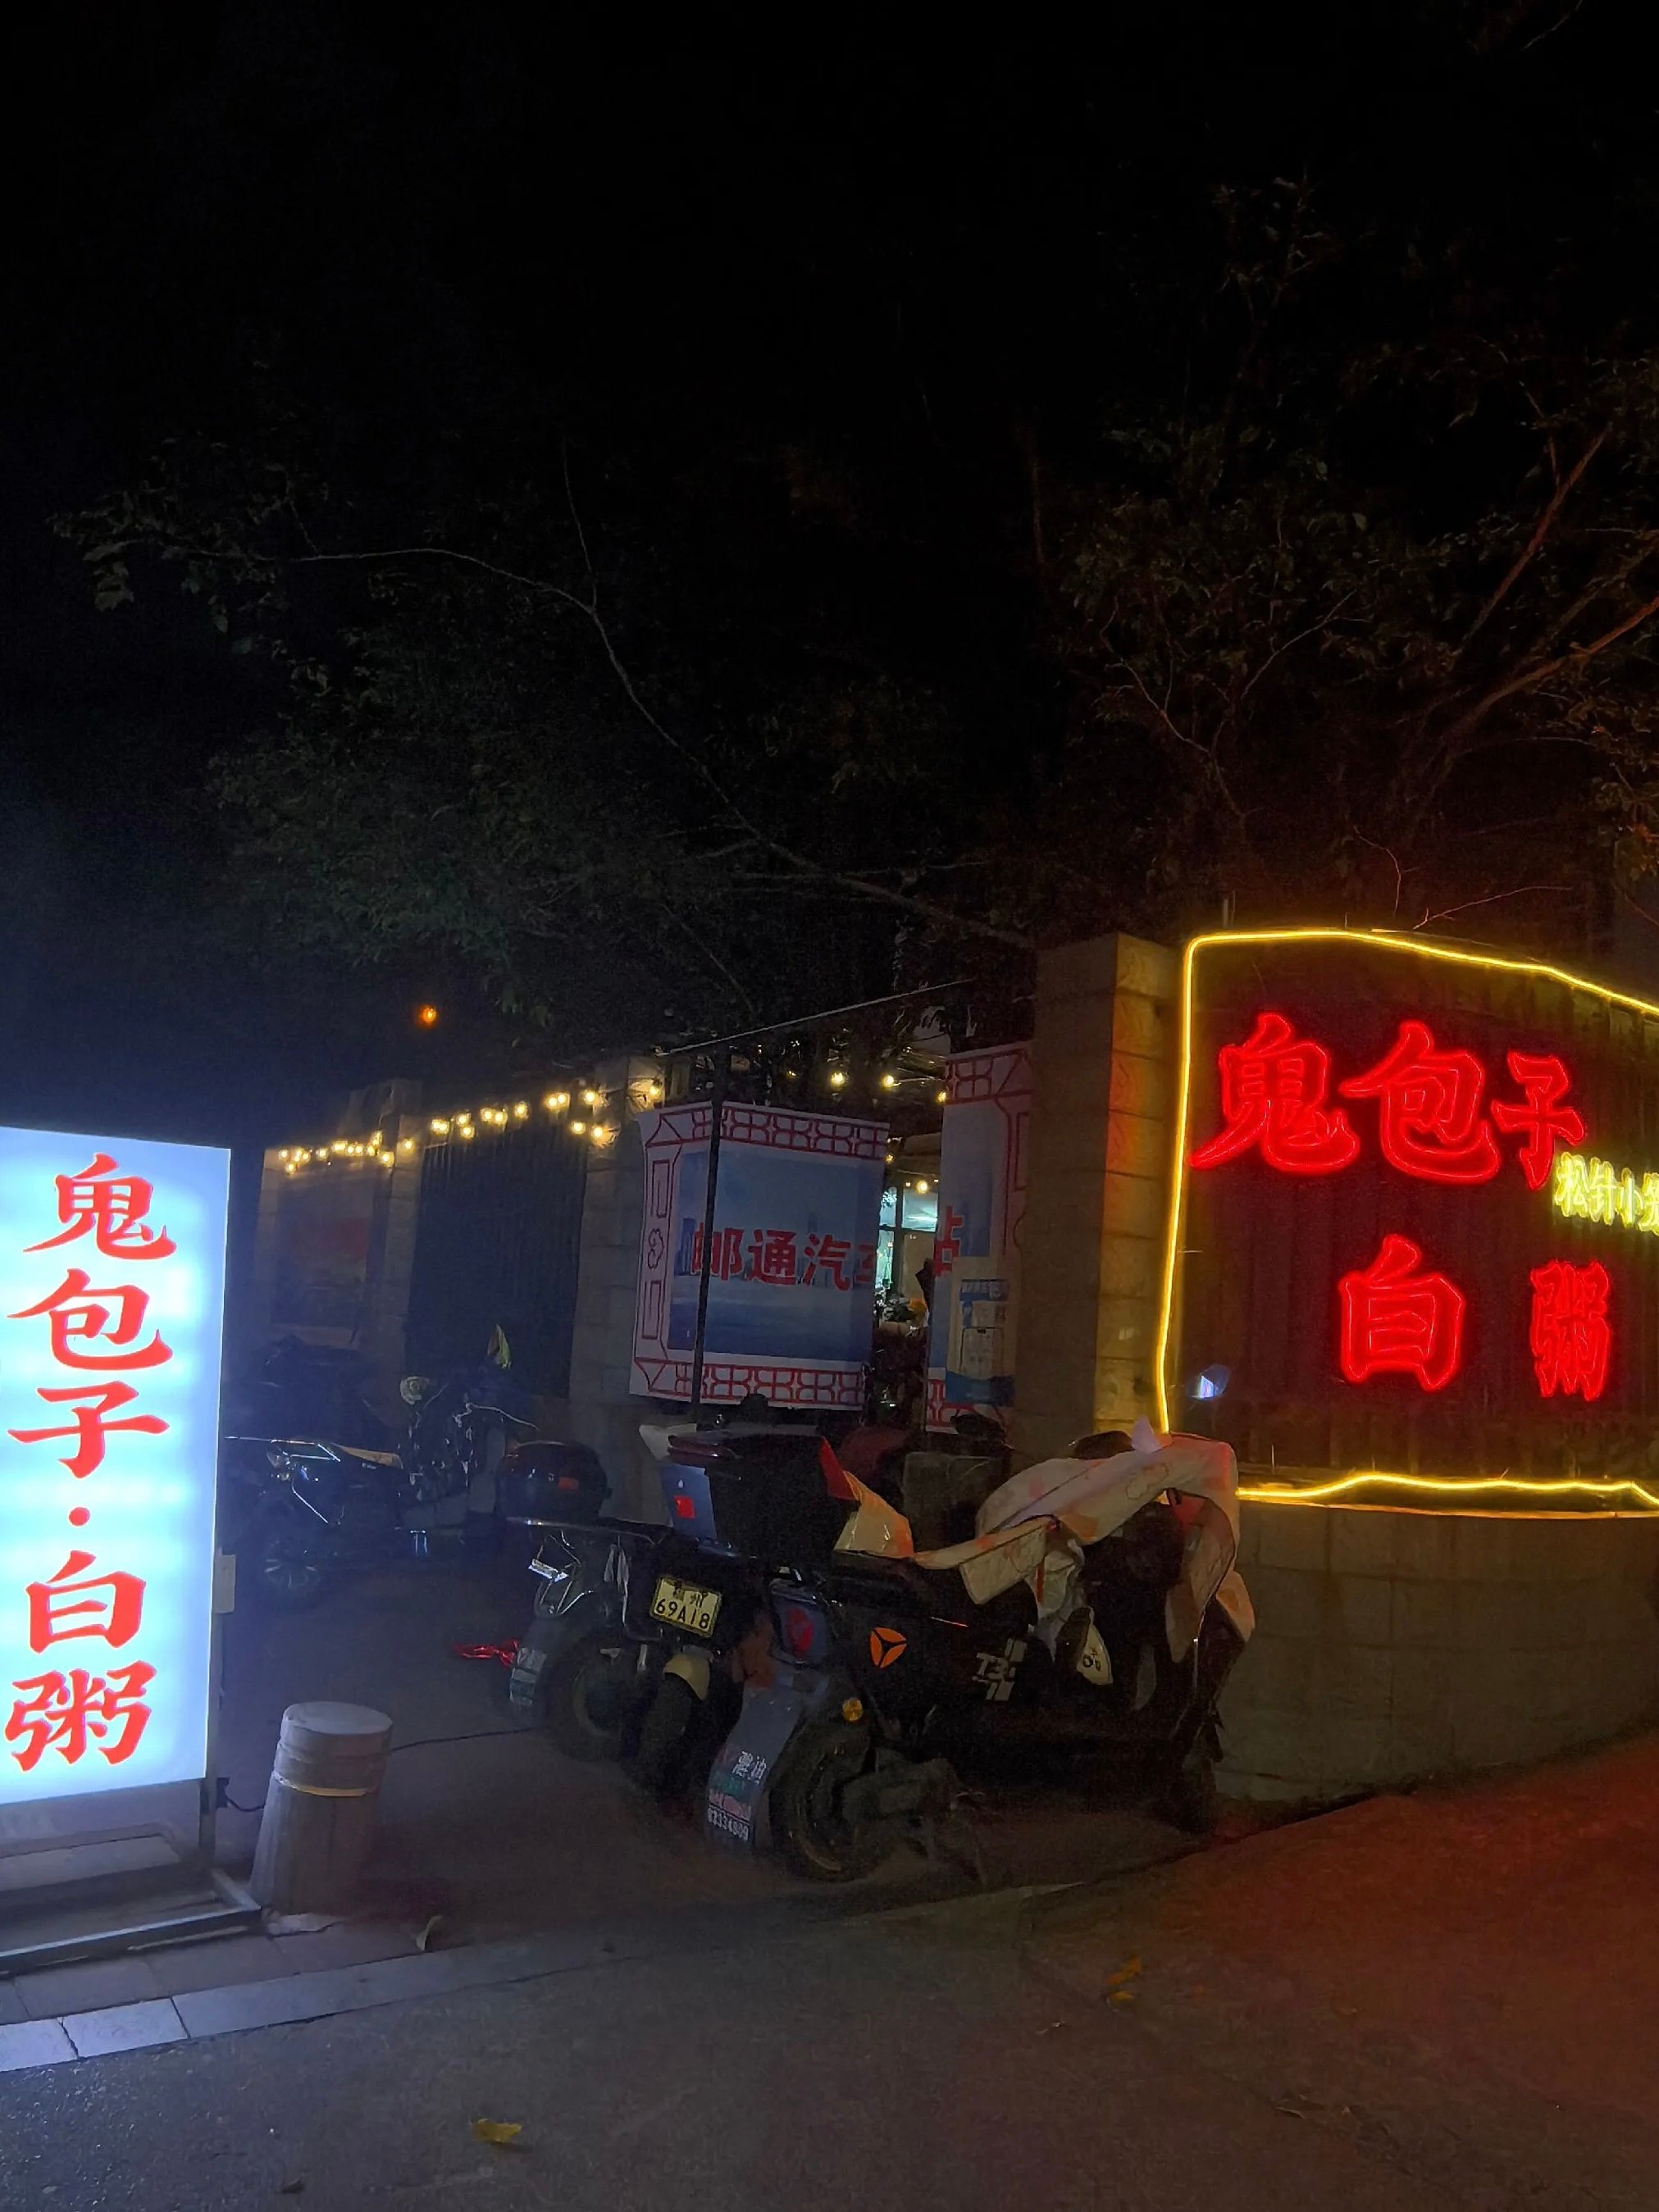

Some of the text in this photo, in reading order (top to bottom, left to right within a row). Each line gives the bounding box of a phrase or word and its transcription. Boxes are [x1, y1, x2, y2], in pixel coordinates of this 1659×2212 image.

[1189, 1012, 1586, 1190] 鬼包子
[1338, 1234, 1611, 1401] 白粥
[655, 1598, 710, 1629] 69A18
